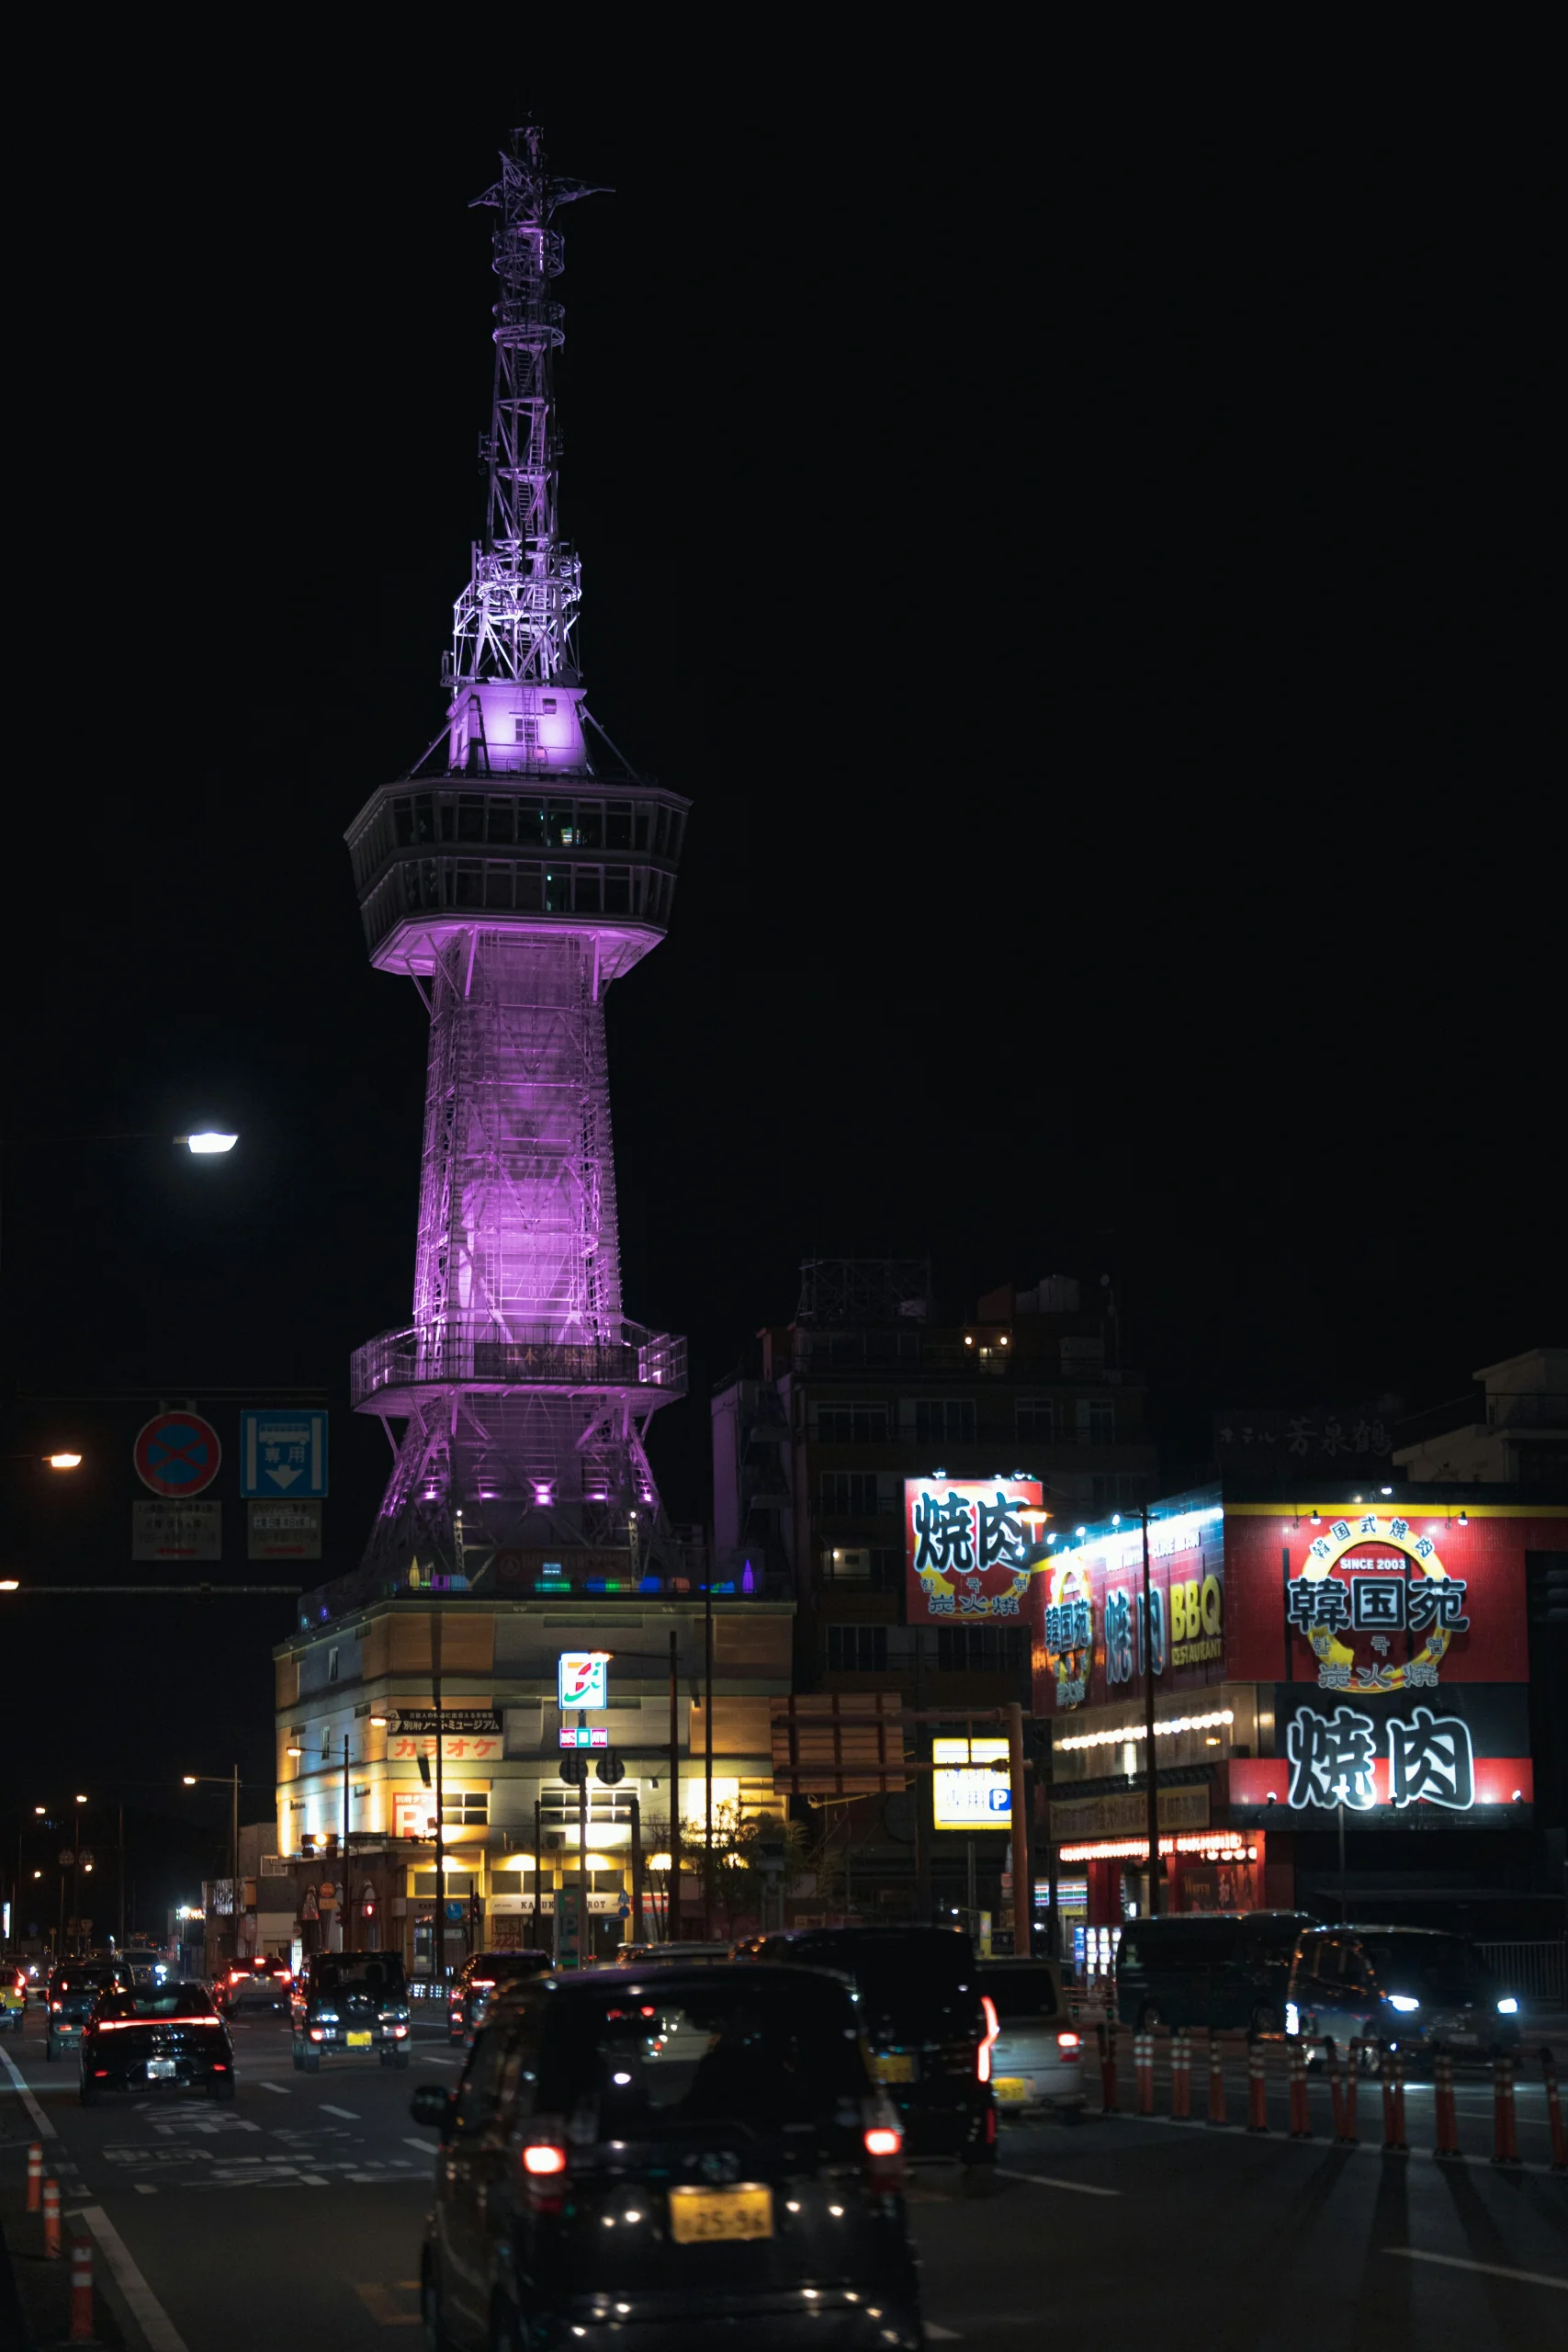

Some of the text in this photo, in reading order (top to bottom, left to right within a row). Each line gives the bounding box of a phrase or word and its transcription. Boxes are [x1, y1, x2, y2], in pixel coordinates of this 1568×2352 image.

[264, 1446, 305, 1464] 専用
[912, 1488, 1032, 1574] 焼肉
[1310, 1514, 1435, 1560] 韓国式焼肉
[1339, 1558, 1406, 1570] SINCE 2003
[928, 1594, 1020, 1616] 炭火焼
[1169, 1574, 1222, 1643] BBQ
[1288, 1576, 1470, 1634] 韓国苑
[1171, 1639, 1223, 1667] RESTAURANT
[1317, 1663, 1438, 1689] 炭火焼
[394, 1738, 498, 1758] カラオケ
[1287, 1706, 1474, 1810] 焼肉
